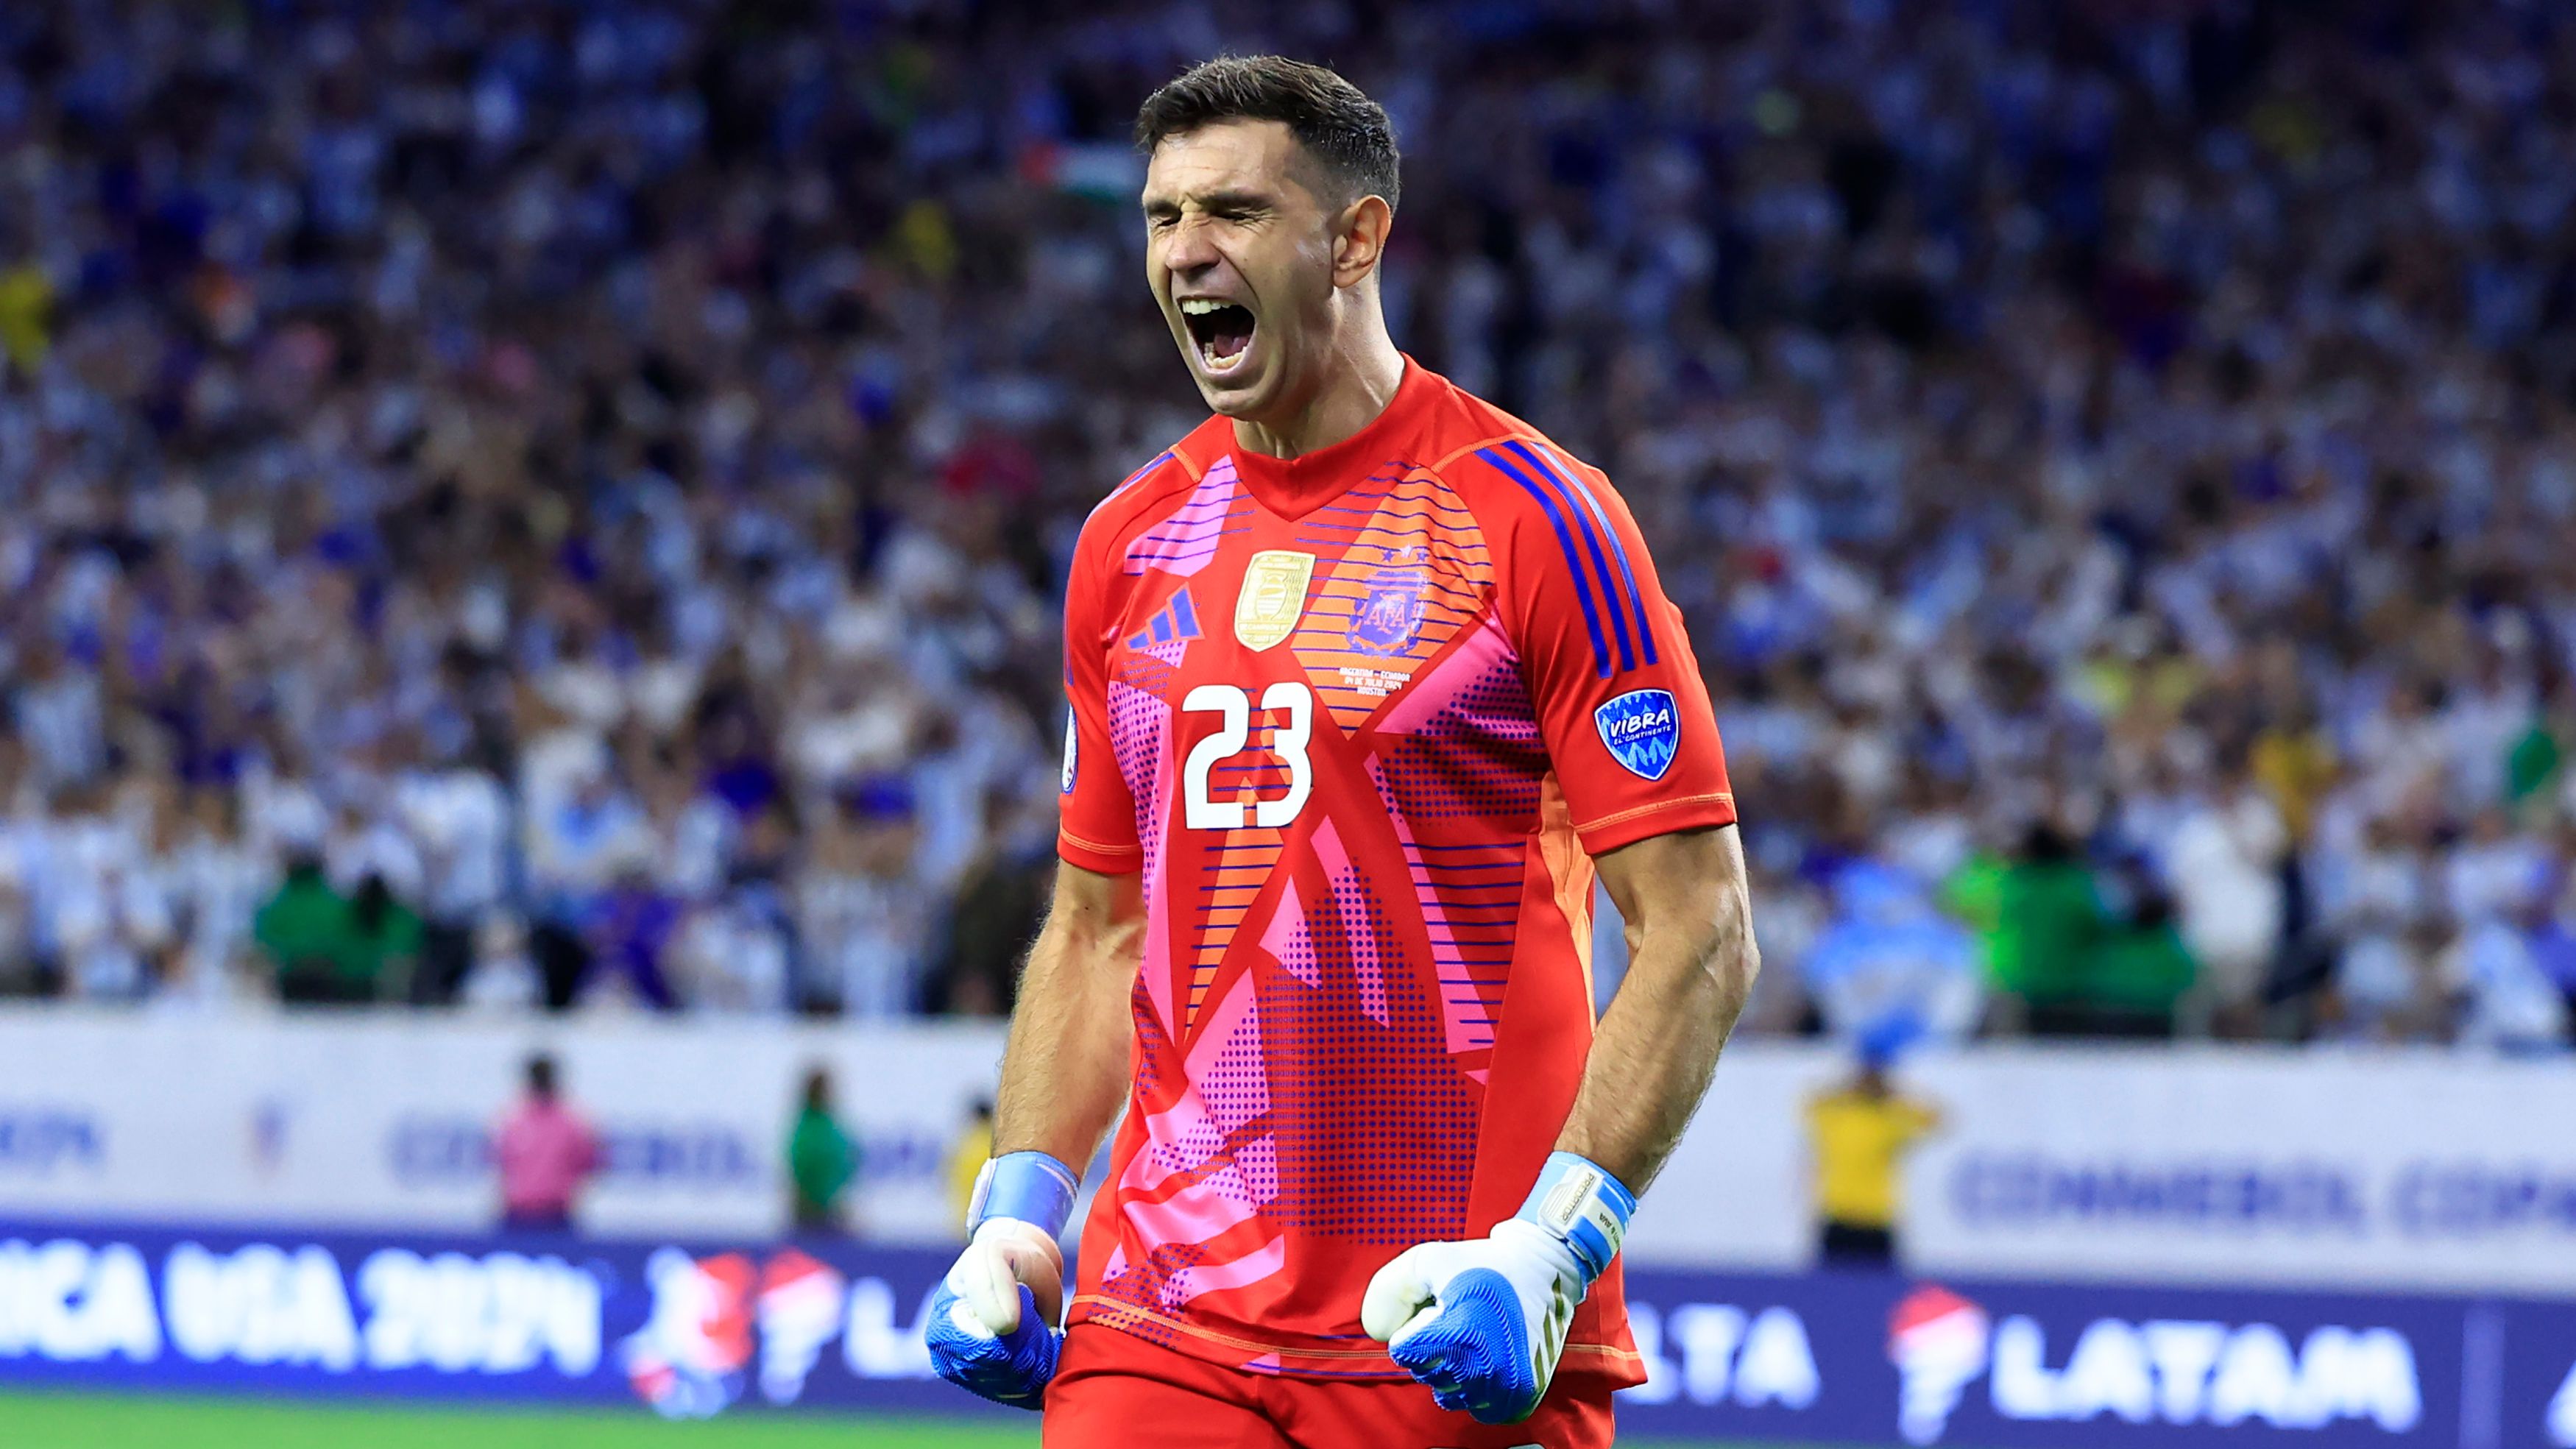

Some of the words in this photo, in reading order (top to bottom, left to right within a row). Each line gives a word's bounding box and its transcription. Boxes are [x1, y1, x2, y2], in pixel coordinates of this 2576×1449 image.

[1364, 595, 1406, 635] AFA
[1610, 709, 1670, 737] VIBRA
[1614, 737, 1624, 745] EL
[1625, 724, 1671, 742] CONTINENTE
[1182, 681, 1314, 829] 23
[1562, 1172, 1595, 1222] PREDATOR
[1989, 1312, 2424, 1434] LATAM
